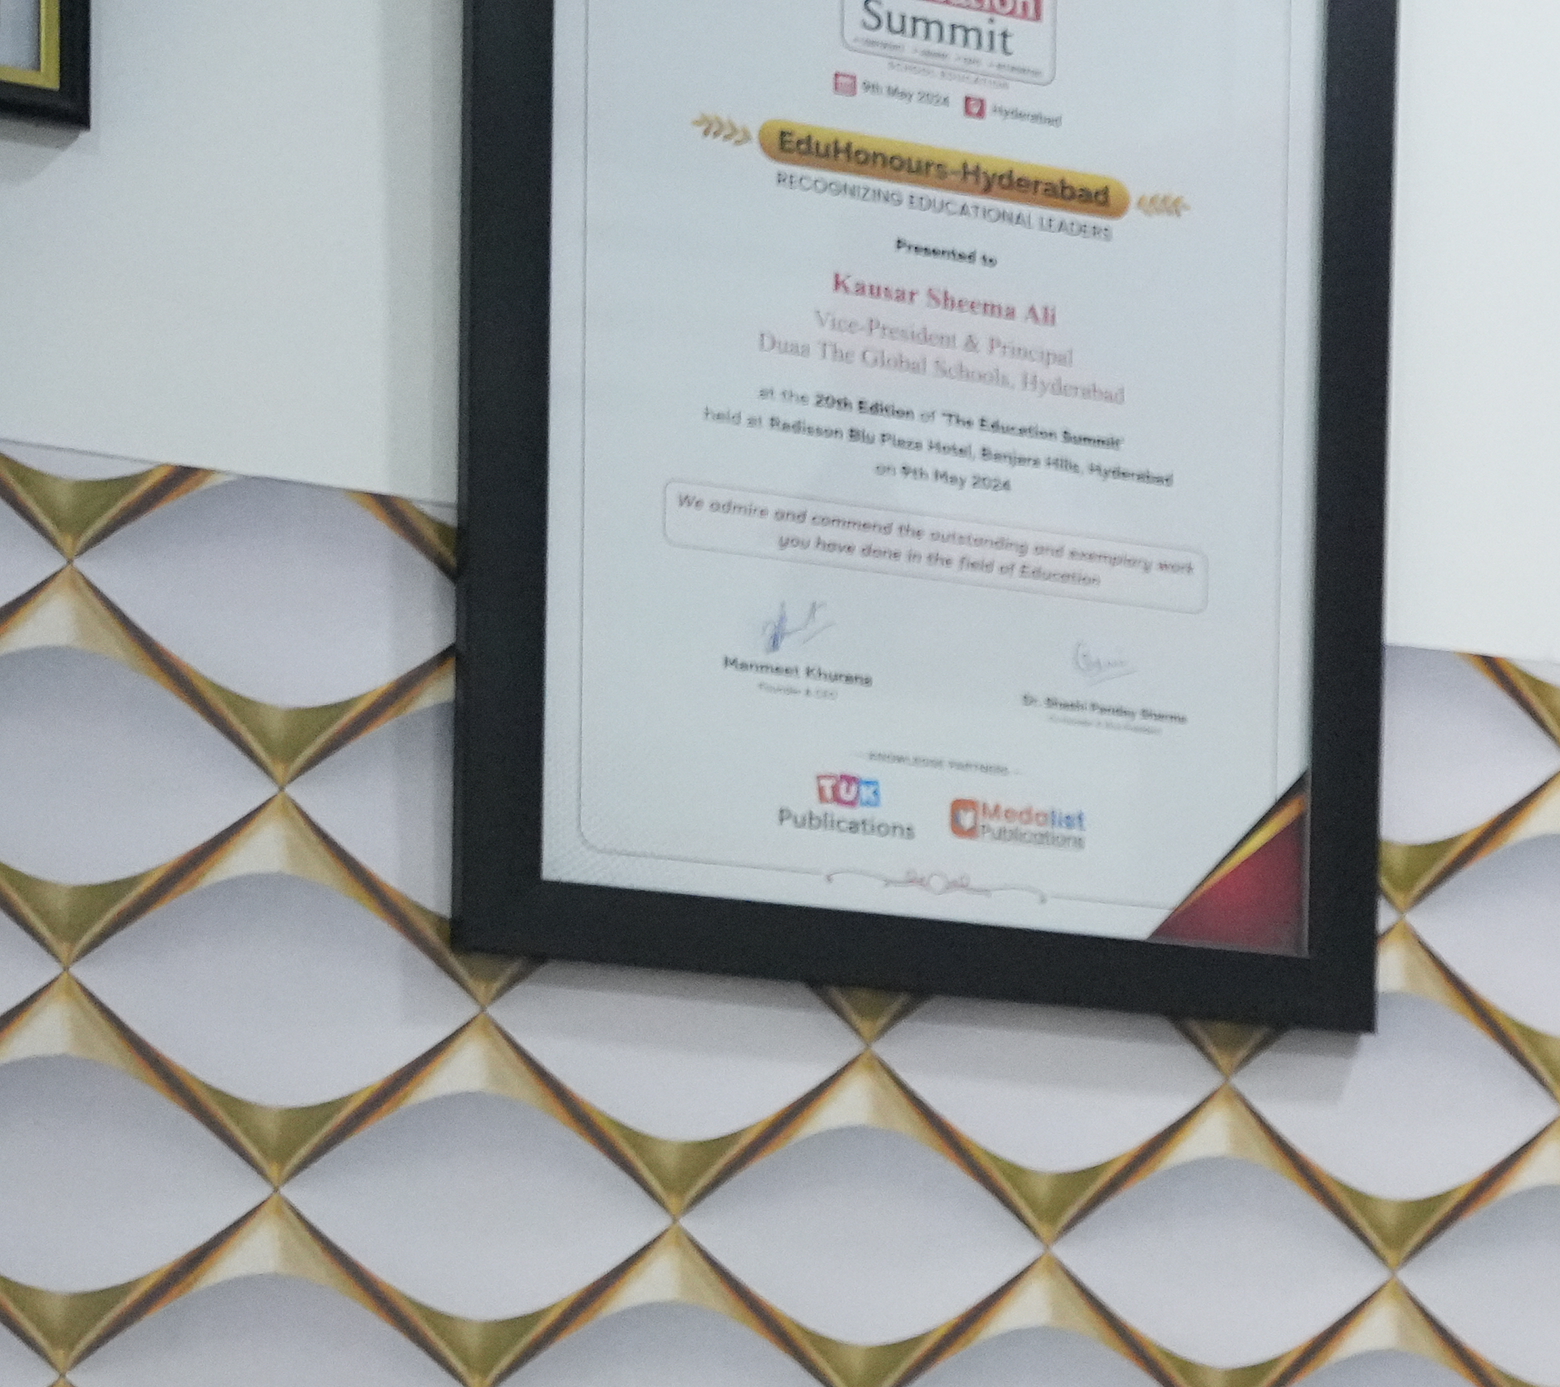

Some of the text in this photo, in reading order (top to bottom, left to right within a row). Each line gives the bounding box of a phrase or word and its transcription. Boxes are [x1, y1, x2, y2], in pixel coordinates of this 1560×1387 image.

[861, 0, 1014, 56] Summit
[886, 85, 912, 104] May
[916, 90, 950, 109] 2024
[991, 104, 1062, 129] Hyderabad
[778, 130, 1110, 212] EduHonours-Hyderabad
[776, 171, 1112, 242] RECOGNIZING EDUCATIONAL LEADERS
[895, 238, 997, 267] Presented to
[832, 272, 1055, 327] Kausar Sheema Ali
[814, 309, 1073, 369] Vice-President & Principal
[757, 332, 1125, 408] Duaa The Global Schools, Hyderabad
[857, 398, 914, 421] Edition
[979, 416, 1057, 442] Education
[768, 416, 843, 440] Radisson
[848, 427, 875, 445] Blu
[880, 431, 923, 452] Plaza
[981, 446, 1039, 472] Banjara
[1088, 461, 1173, 489] Hyderabad
[933, 469, 966, 490] May
[971, 474, 1011, 493] 2024
[677, 494, 1193, 576] We admire and commend the outstanding and exemplary work
[778, 533, 1100, 589] you have done in the field of Education
[819, 773, 880, 809] TUK
[981, 799, 1086, 831] Medalist
[778, 806, 916, 841] Publications
[980, 824, 1085, 851] Publications
